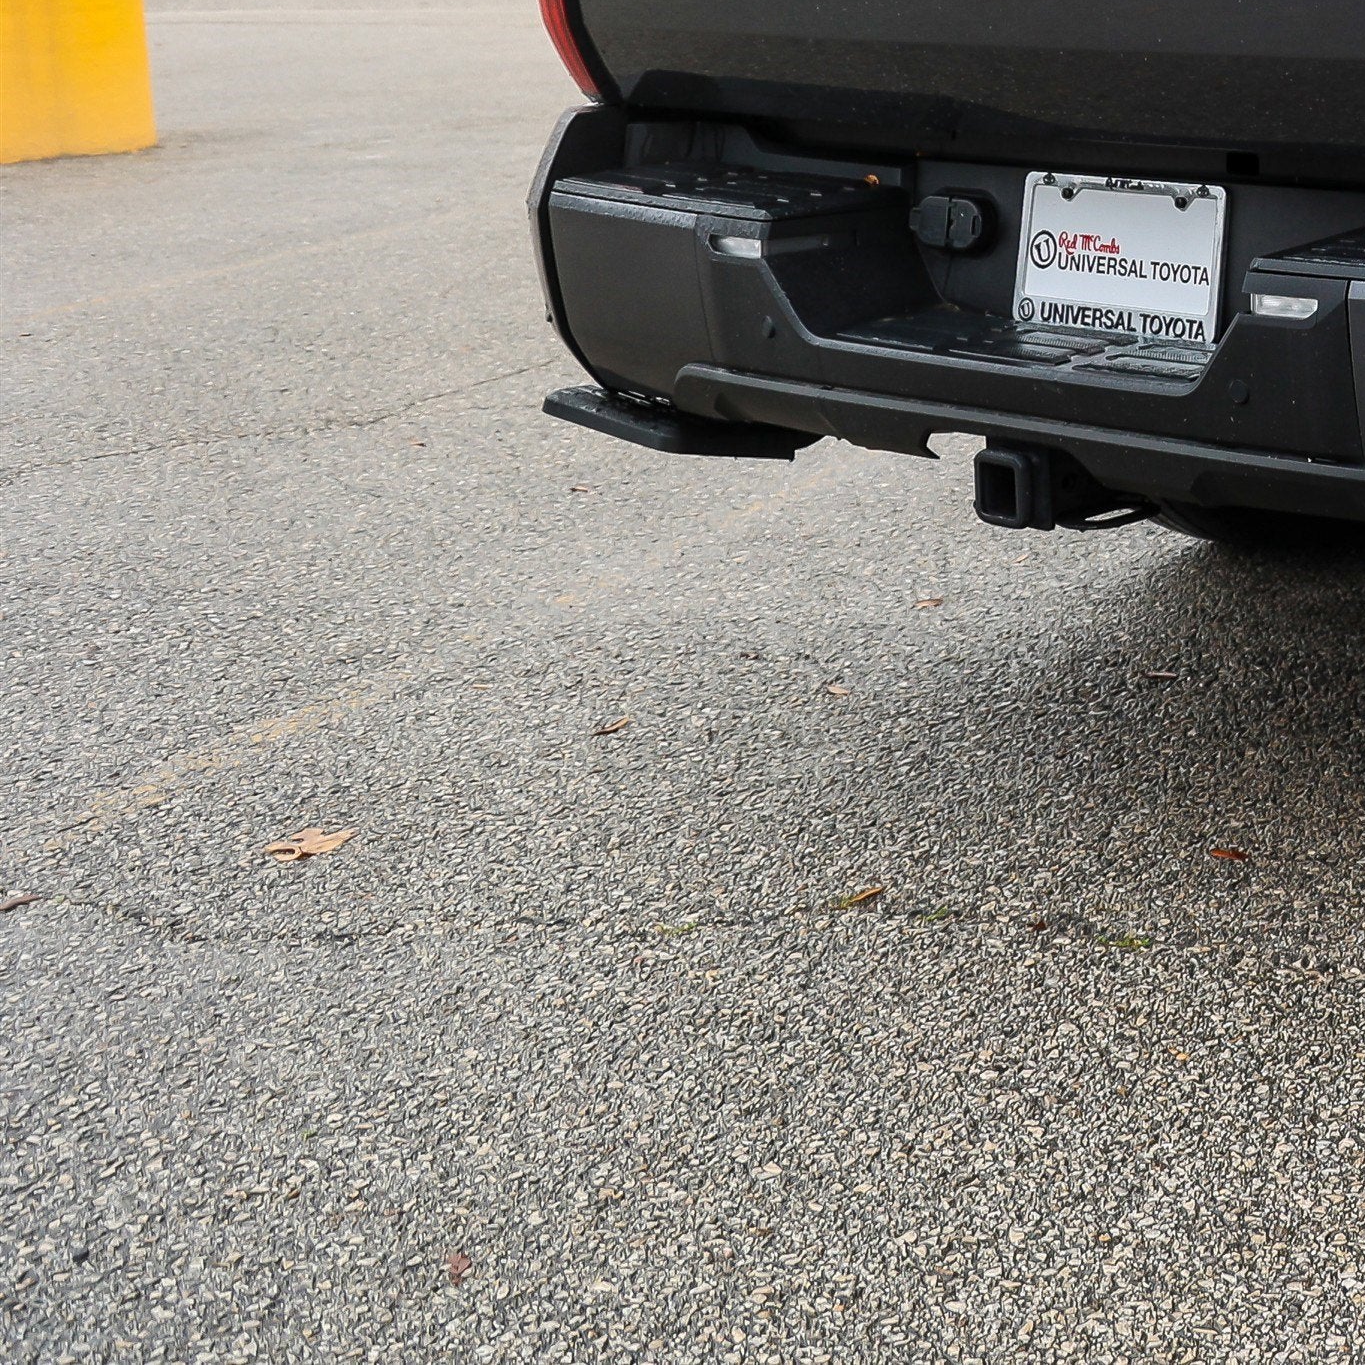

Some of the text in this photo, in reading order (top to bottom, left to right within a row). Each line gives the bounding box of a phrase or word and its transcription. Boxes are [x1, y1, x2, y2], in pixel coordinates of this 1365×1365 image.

[1058, 231, 1077, 255] Red
[1057, 252, 1210, 286] UNIVERSAL TOYOTA
[1040, 301, 1206, 342] UNIVERSAL TOYOTA
